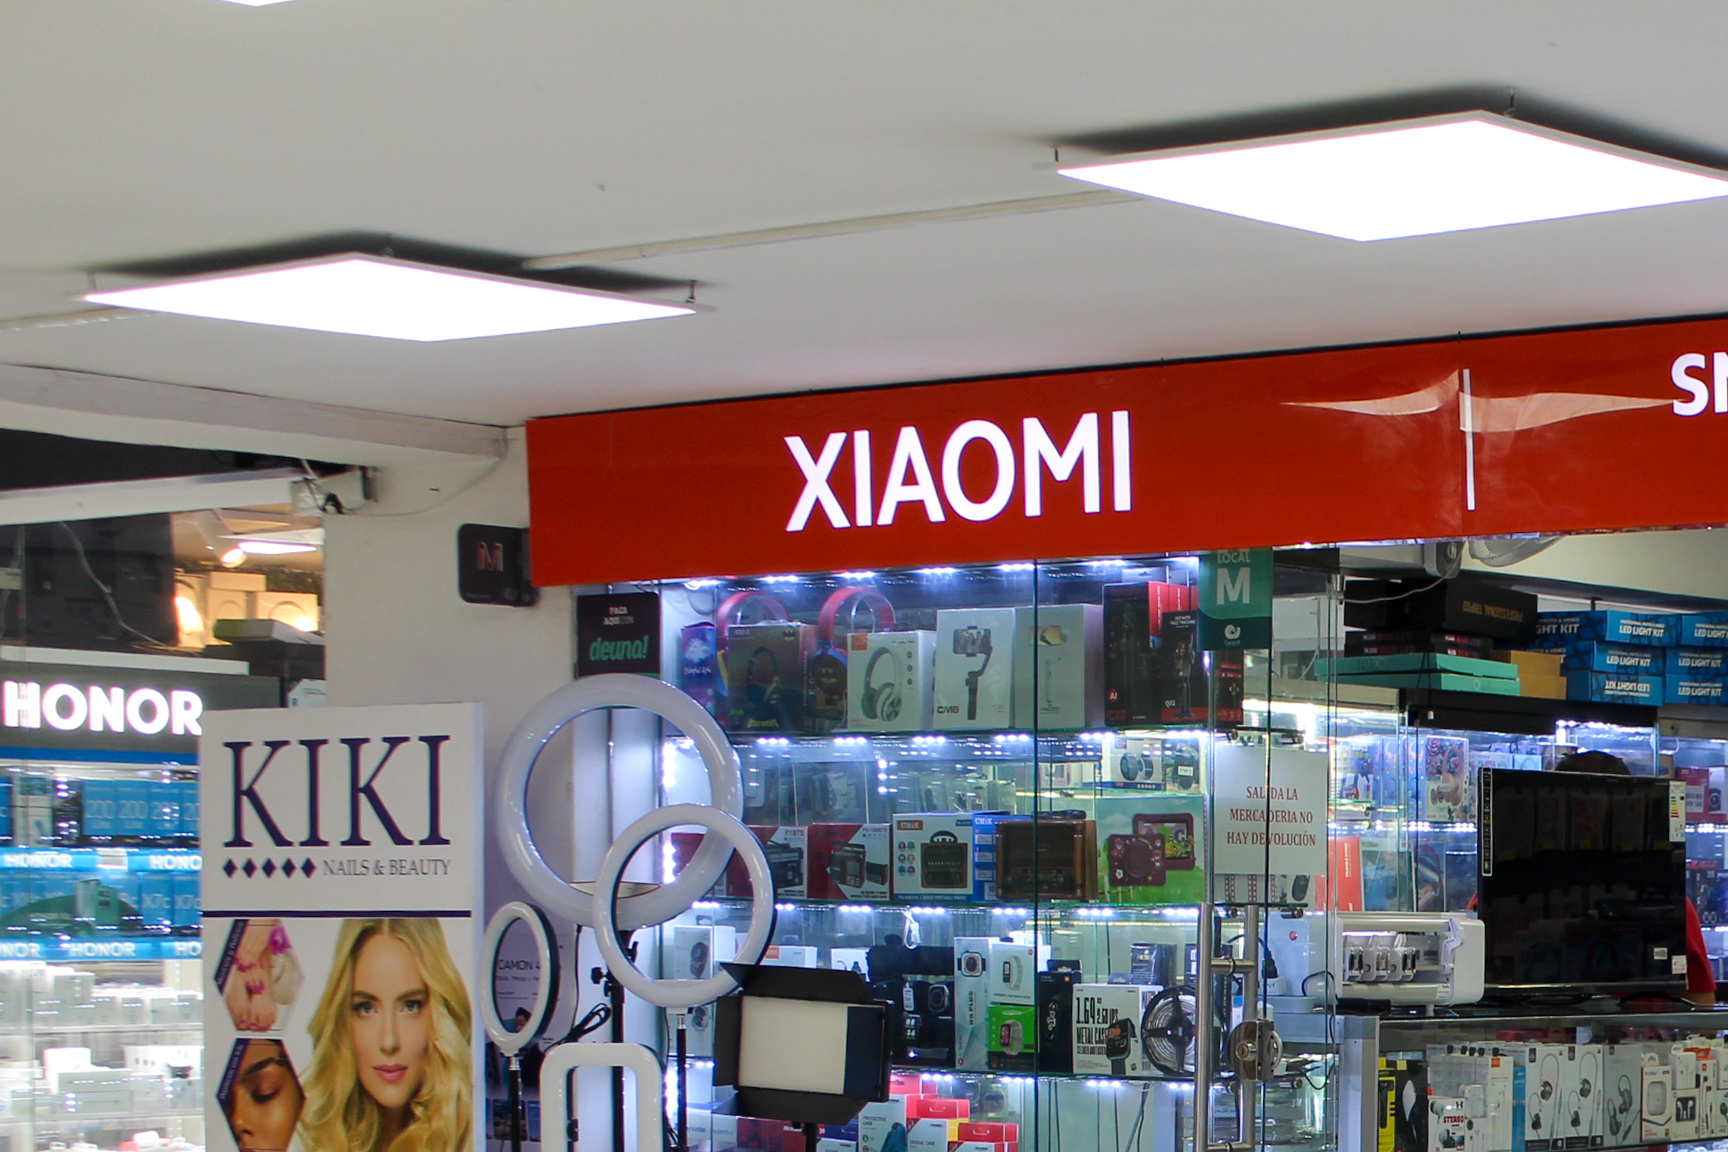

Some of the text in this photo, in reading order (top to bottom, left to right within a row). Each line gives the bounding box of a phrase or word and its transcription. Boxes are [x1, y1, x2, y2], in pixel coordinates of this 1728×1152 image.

[784, 410, 1132, 531] XIAOMI
[1217, 552, 1251, 564] LOCAL
[1215, 567, 1251, 605] M
[1536, 623, 1579, 635] GHT KIT
[1619, 624, 1665, 638] LED LIGHT KIT
[1694, 628, 1708, 638] LED
[1708, 629, 1725, 639] LIGHT
[588, 635, 649, 661] deuna!
[1606, 655, 1652, 668] LED LIGHT KIT
[1678, 657, 1722, 668] LED LIGHT KIT
[1678, 686, 1723, 697] LED LIGHT KIT
[3, 680, 203, 736] HONOR
[222, 735, 451, 847] KIKI
[1246, 786, 1299, 800] SALDA LA
[1230, 808, 1314, 824] MERCADERIA NO
[1227, 830, 1316, 846] HAY DEVOLUCIÓN
[5, 854, 73, 869] HONOR
[150, 854, 203, 870] HONO
[323, 859, 451, 876] NAILS & BEAUTY
[0, 943, 137, 958] NOR HONOR
